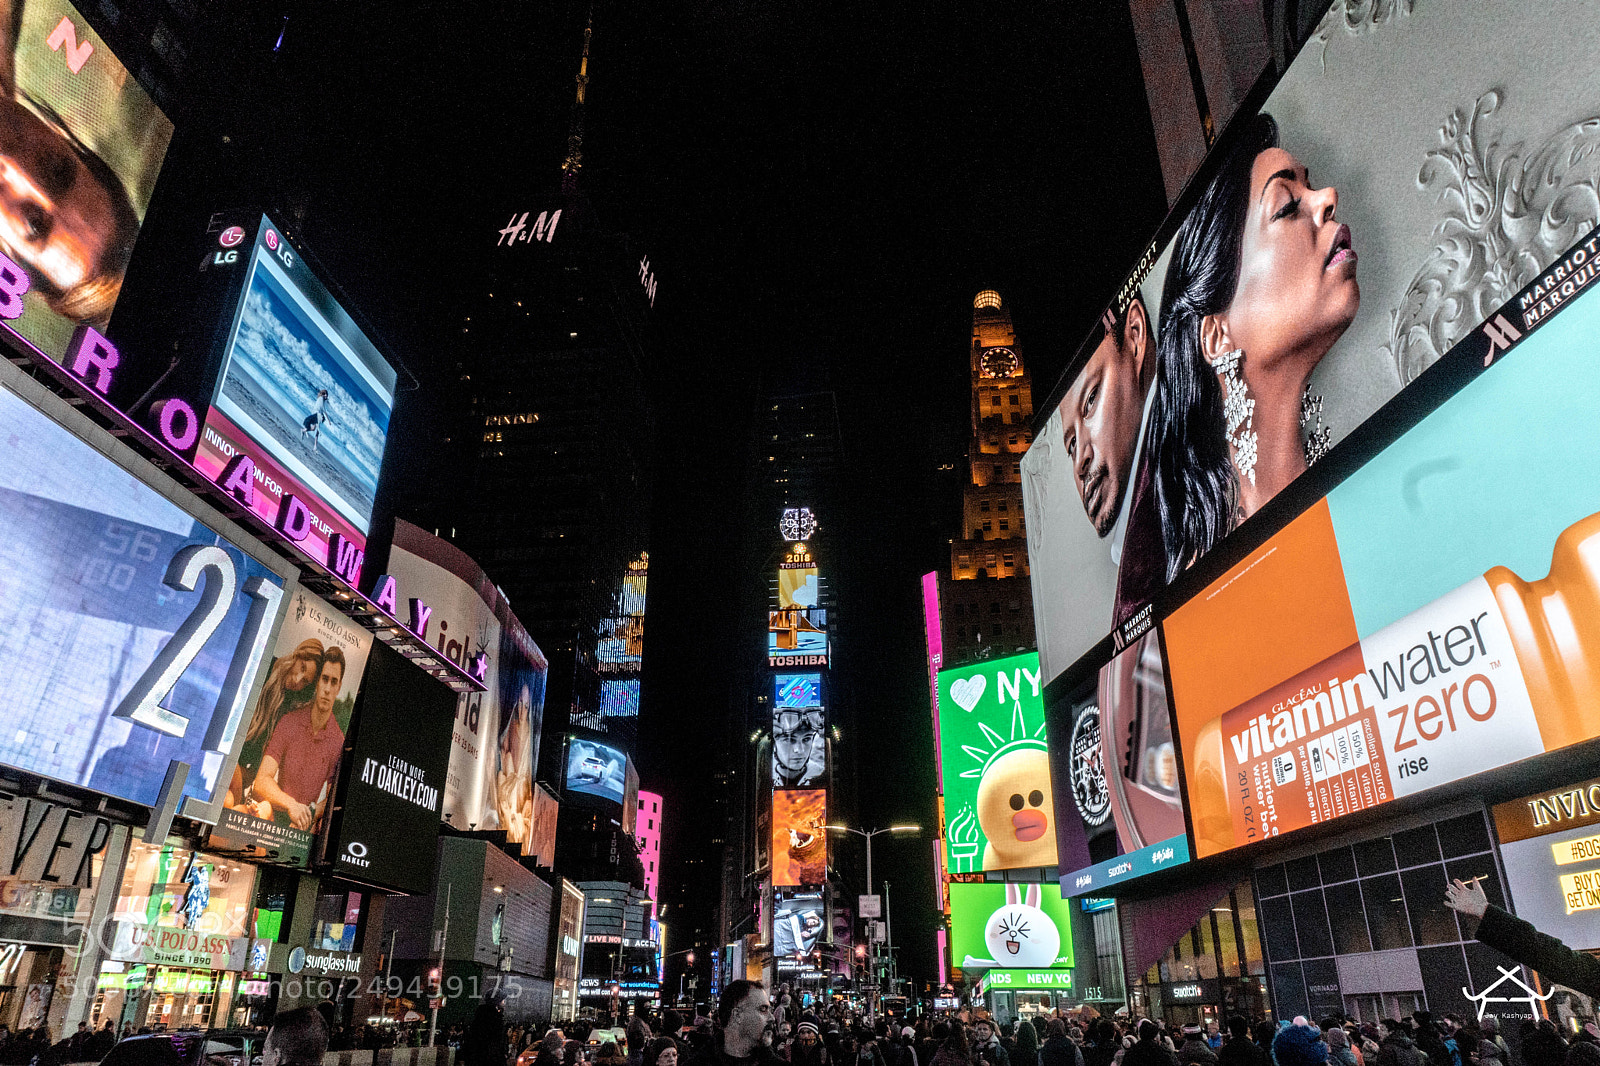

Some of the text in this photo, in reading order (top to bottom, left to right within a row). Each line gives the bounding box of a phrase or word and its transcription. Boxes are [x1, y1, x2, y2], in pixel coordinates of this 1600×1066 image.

[497, 209, 562, 247] H&M
[214, 250, 238, 265] LG
[277, 242, 293, 268] LG
[638, 254, 657, 309] H&M
[1118, 241, 1157, 304] MARRIOTT
[1520, 232, 1600, 310] MARRIOT
[205, 427, 265, 483] INNOVON
[264, 477, 282, 498] FOR
[779, 561, 817, 570] TOSHIBA
[786, 554, 811, 563] 2018
[309, 608, 361, 649] U.S. POLO ASSN.
[1124, 603, 1153, 633] MARRIOTT
[1125, 617, 1151, 643] MARQUIS
[317, 628, 333, 641] SINCE
[118, 544, 284, 756] 21
[769, 655, 828, 667] TOSHIBA
[1230, 610, 1488, 765] vitamin water
[1271, 682, 1322, 714] GLACÉAU
[455, 689, 482, 736] rld
[1387, 673, 1498, 753] zero
[1297, 745, 1306, 760] per
[1337, 735, 1350, 764] 100%
[1351, 729, 1364, 759] 150%
[388, 754, 409, 774] LEARN
[409, 763, 426, 783] MORE
[1283, 762, 1293, 772] 0
[1363, 717, 1387, 800] excellent source
[1398, 753, 1429, 779] rise
[361, 757, 439, 812] AT OAKLEY.COM
[1237, 770, 1249, 787] 20
[1253, 763, 1266, 811] water
[1301, 760, 1311, 790] bottle,
[1240, 787, 1251, 804] FL
[1261, 760, 1279, 822] nutrient
[1306, 791, 1314, 808] see
[1319, 787, 1332, 821] electr
[228, 813, 248, 826] LIVE
[250, 821, 310, 843] AUTHENTICALLY
[1243, 805, 1254, 825] OZ
[0, 790, 111, 889] VER
[341, 854, 371, 868] OAKLEY
[216, 867, 230, 883] $30
[1573, 873, 1592, 892] BUY
[1567, 891, 1585, 908] GET
[131, 927, 236, 957] U.S. POLO ASSN.
[588, 935, 607, 943] LIVE
[154, 952, 211, 965] SINCE 1890
[305, 951, 361, 975] sunglass hut
[990, 973, 1071, 984] NDS NEW YO
[1173, 984, 1197, 998] swatch
[1084, 986, 1102, 999] 1515
